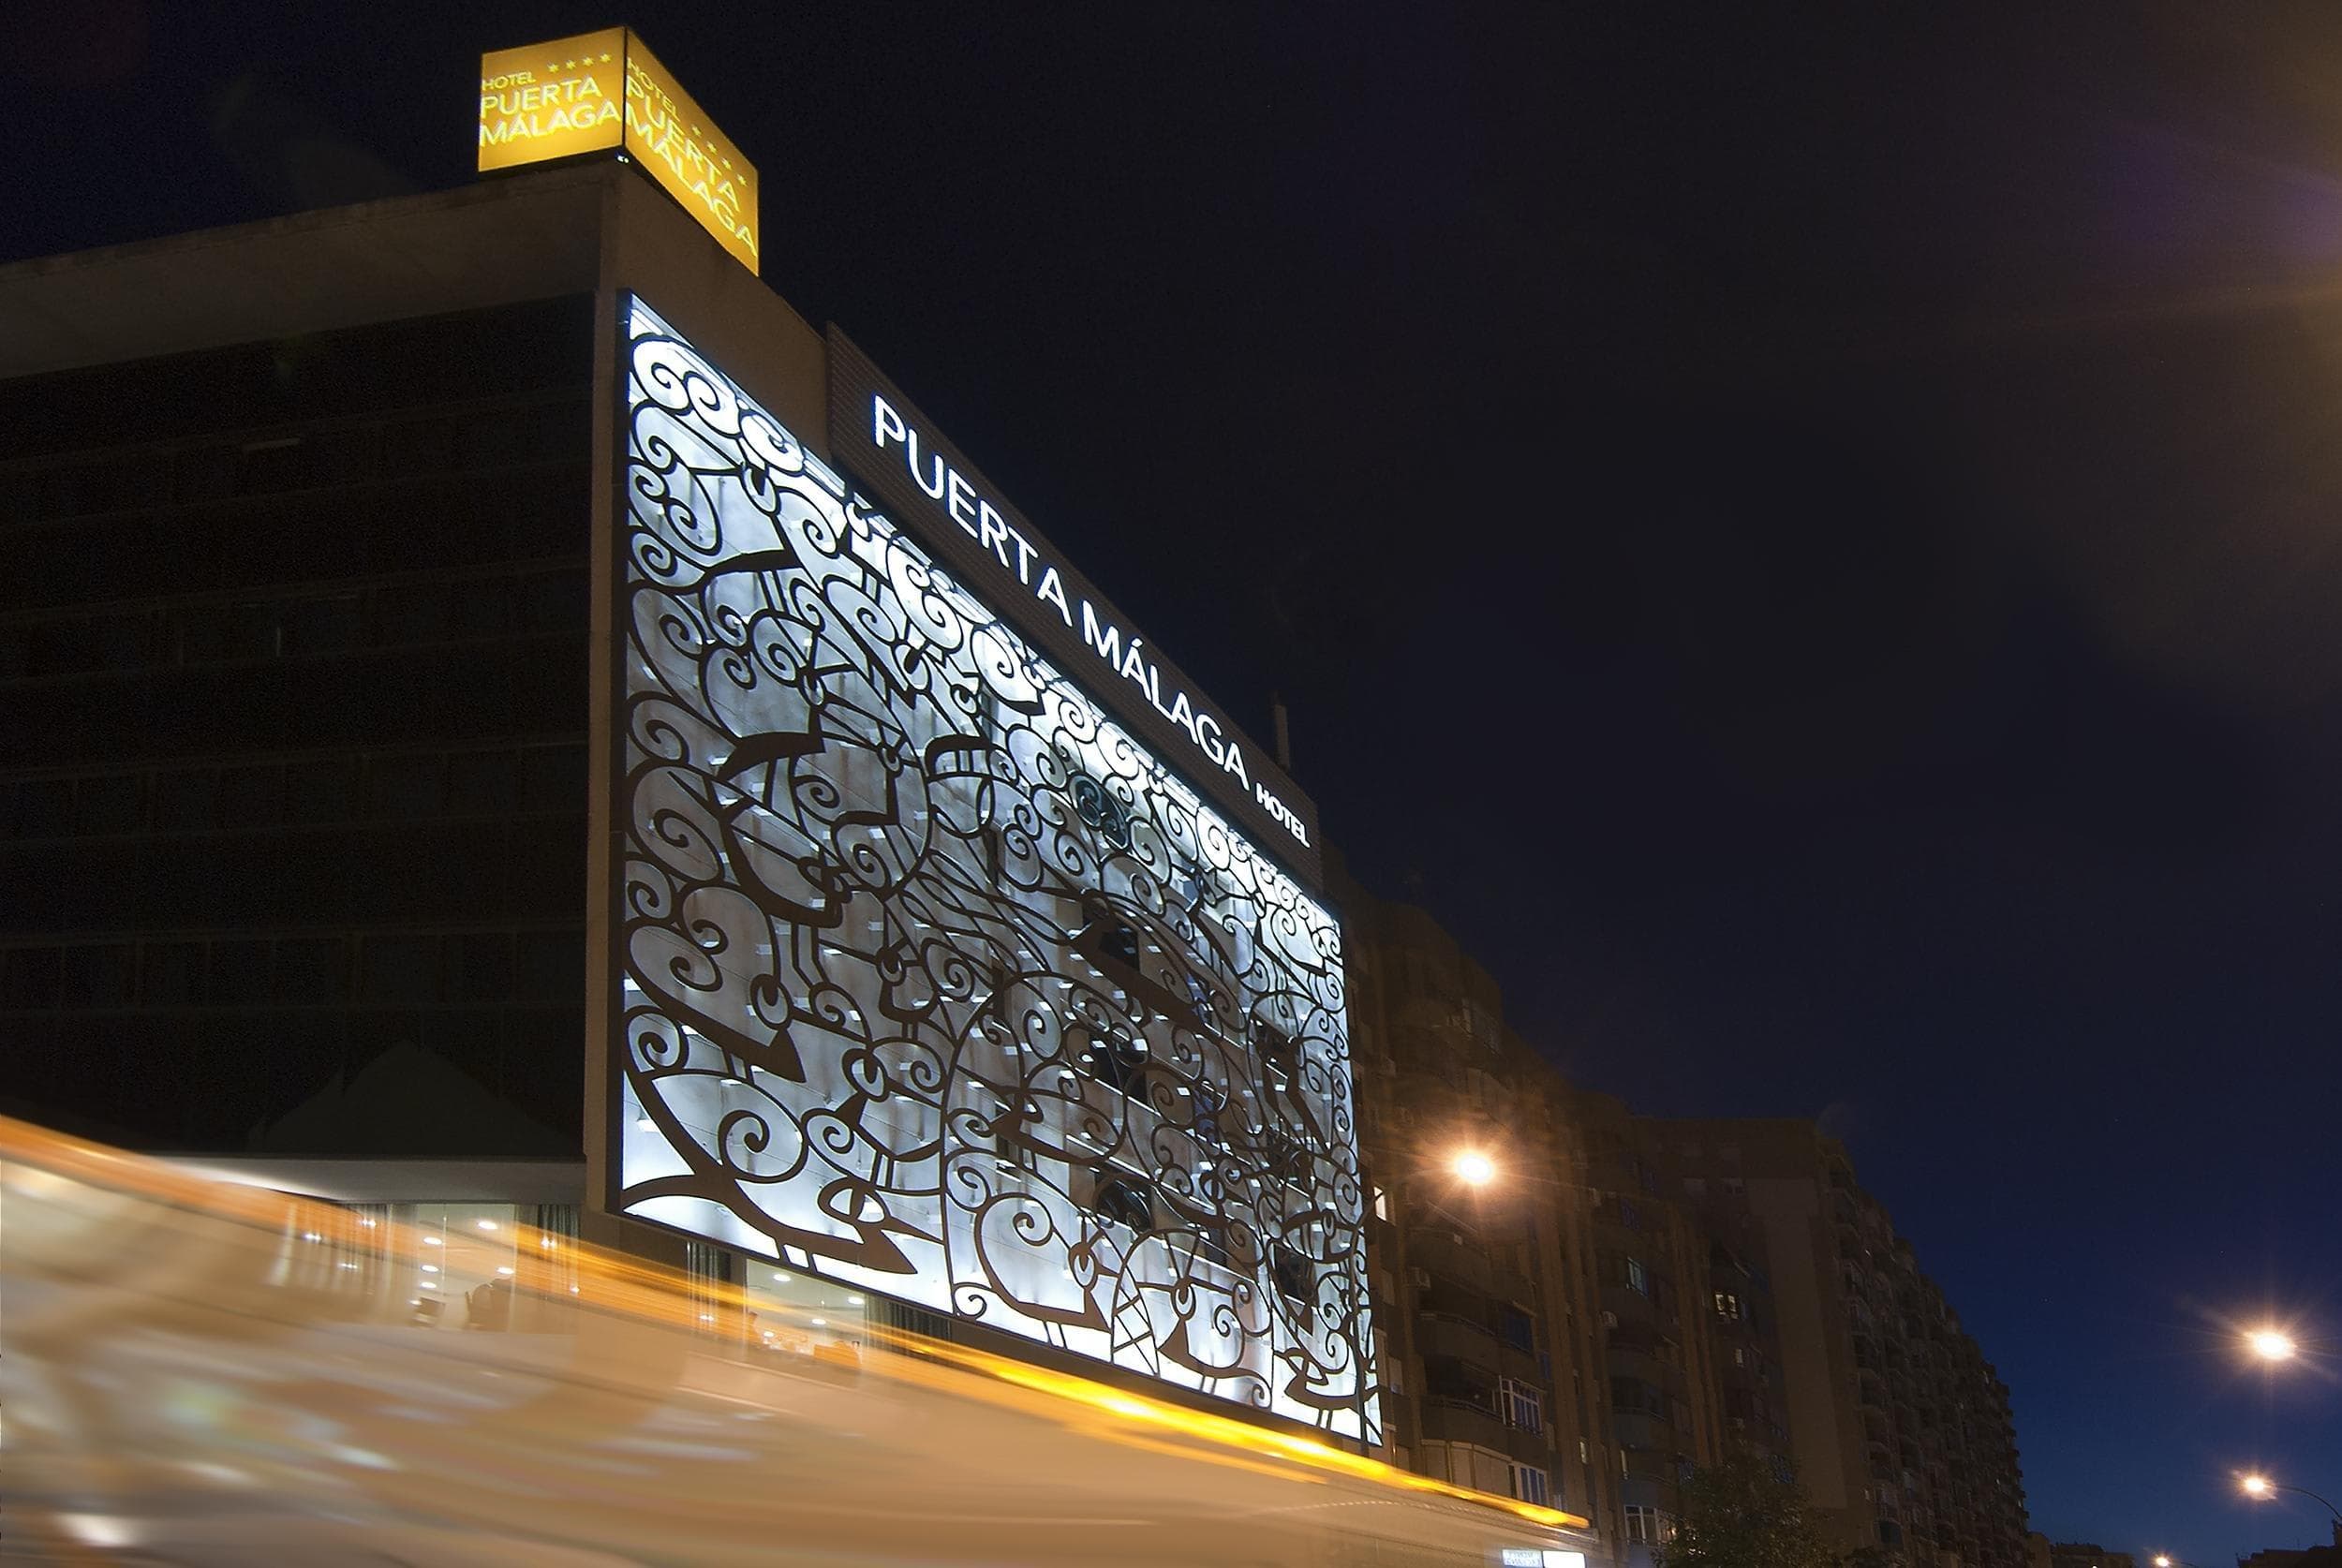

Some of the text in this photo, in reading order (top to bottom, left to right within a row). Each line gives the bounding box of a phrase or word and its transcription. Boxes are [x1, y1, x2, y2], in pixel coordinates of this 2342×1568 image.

[481, 77, 602, 118] PUERTA
[482, 71, 537, 91] HOTEL
[627, 57, 680, 122] HOTEL
[626, 75, 740, 213] PUERTA
[873, 394, 1311, 849] PUERTA MÁLAGA HOTEL
